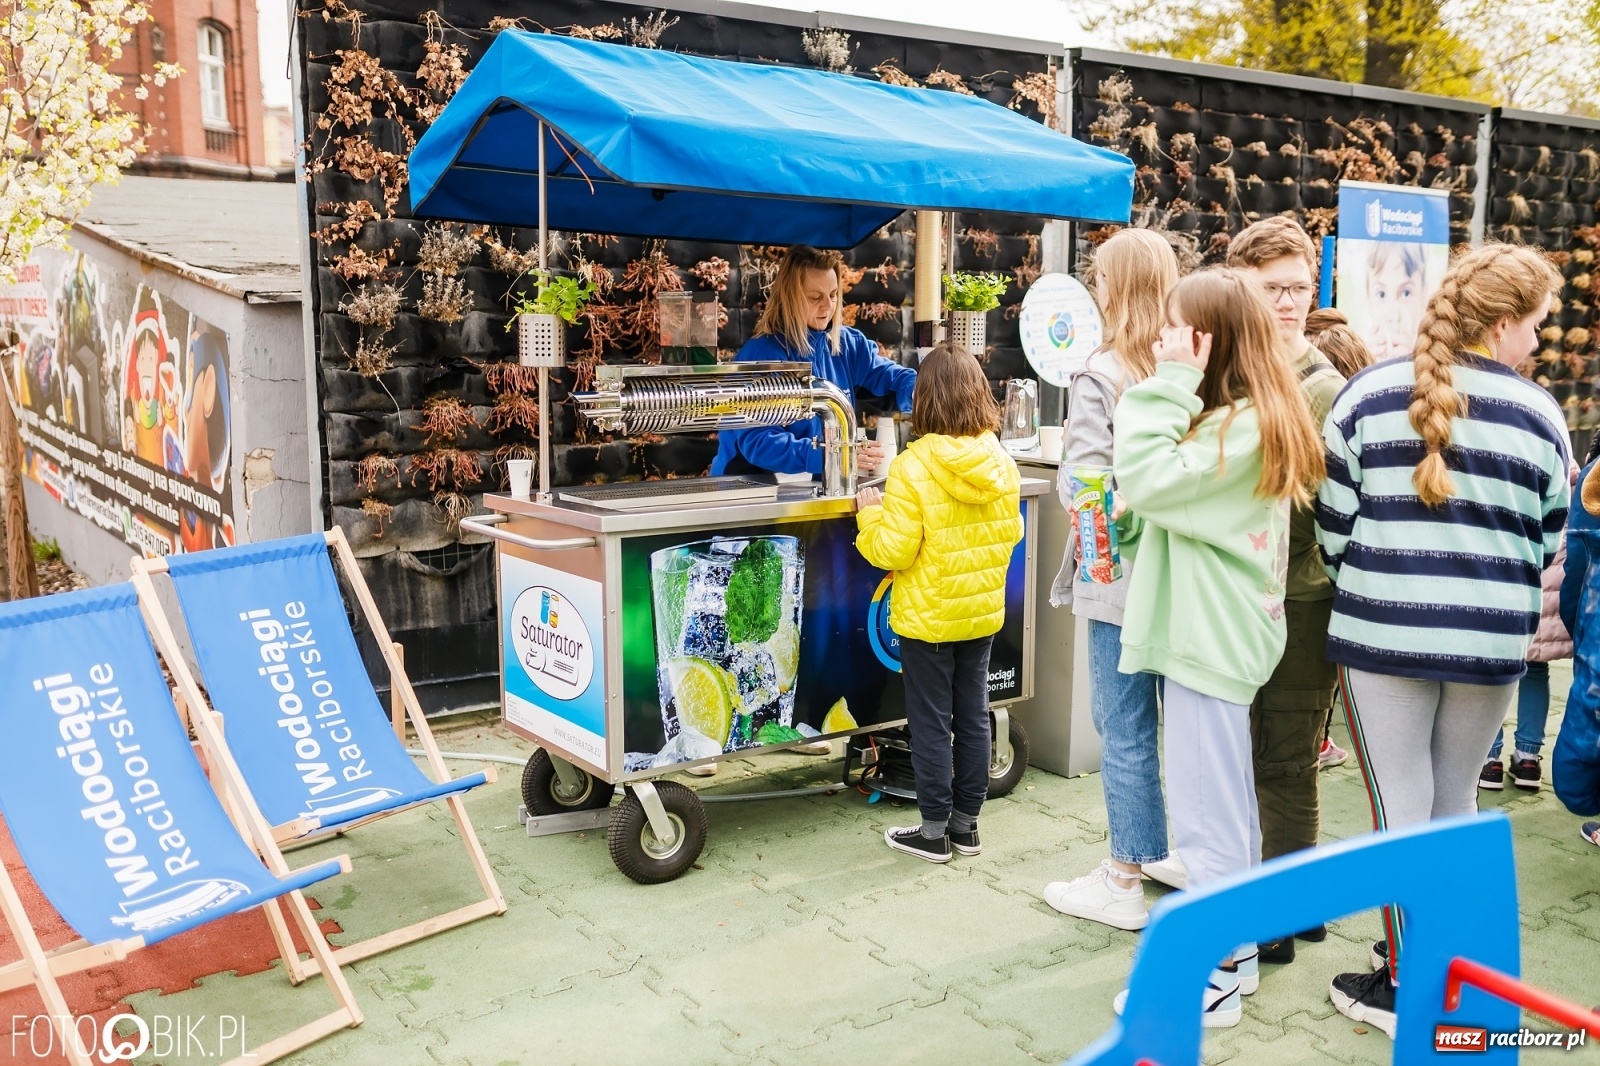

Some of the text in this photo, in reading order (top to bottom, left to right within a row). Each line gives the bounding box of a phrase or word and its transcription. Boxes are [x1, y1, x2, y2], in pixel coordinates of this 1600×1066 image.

[1382, 208, 1423, 226] Wodociągi
[1382, 222, 1423, 237] Raciborskie
[1361, 385, 1416, 401] OKIO PARIS
[1475, 397, 1508, 406] TOKIO
[1364, 440, 1420, 451] OKIO PARIS
[1471, 450, 1503, 460] TOKIO
[1506, 456, 1534, 469] PARIS
[122, 457, 155, 490] zabawy
[155, 471, 168, 491] na
[168, 478, 221, 518] sportowo
[104, 473, 116, 491] na
[115, 476, 143, 506] dużym
[143, 492, 180, 526] ekranie
[1082, 512, 1093, 559] GRANAT
[1396, 549, 1427, 557] PARIS
[1429, 550, 1448, 558] NEW
[1450, 552, 1477, 561] YORK
[1478, 554, 1508, 565] TOKIO
[1366, 598, 1394, 608] TOKIO
[1396, 602, 1428, 610] PARIS
[520, 615, 584, 661] Saturator
[1430, 653, 1451, 661] NEW
[284, 600, 373, 782] Raciborskie
[986, 680, 1015, 692] borskie
[239, 607, 338, 796] Wodociągi
[553, 726, 602, 758] WWW.SATURATOR.EU
[89, 662, 200, 878] Raciborskie
[32, 672, 159, 897] Wodociągi
